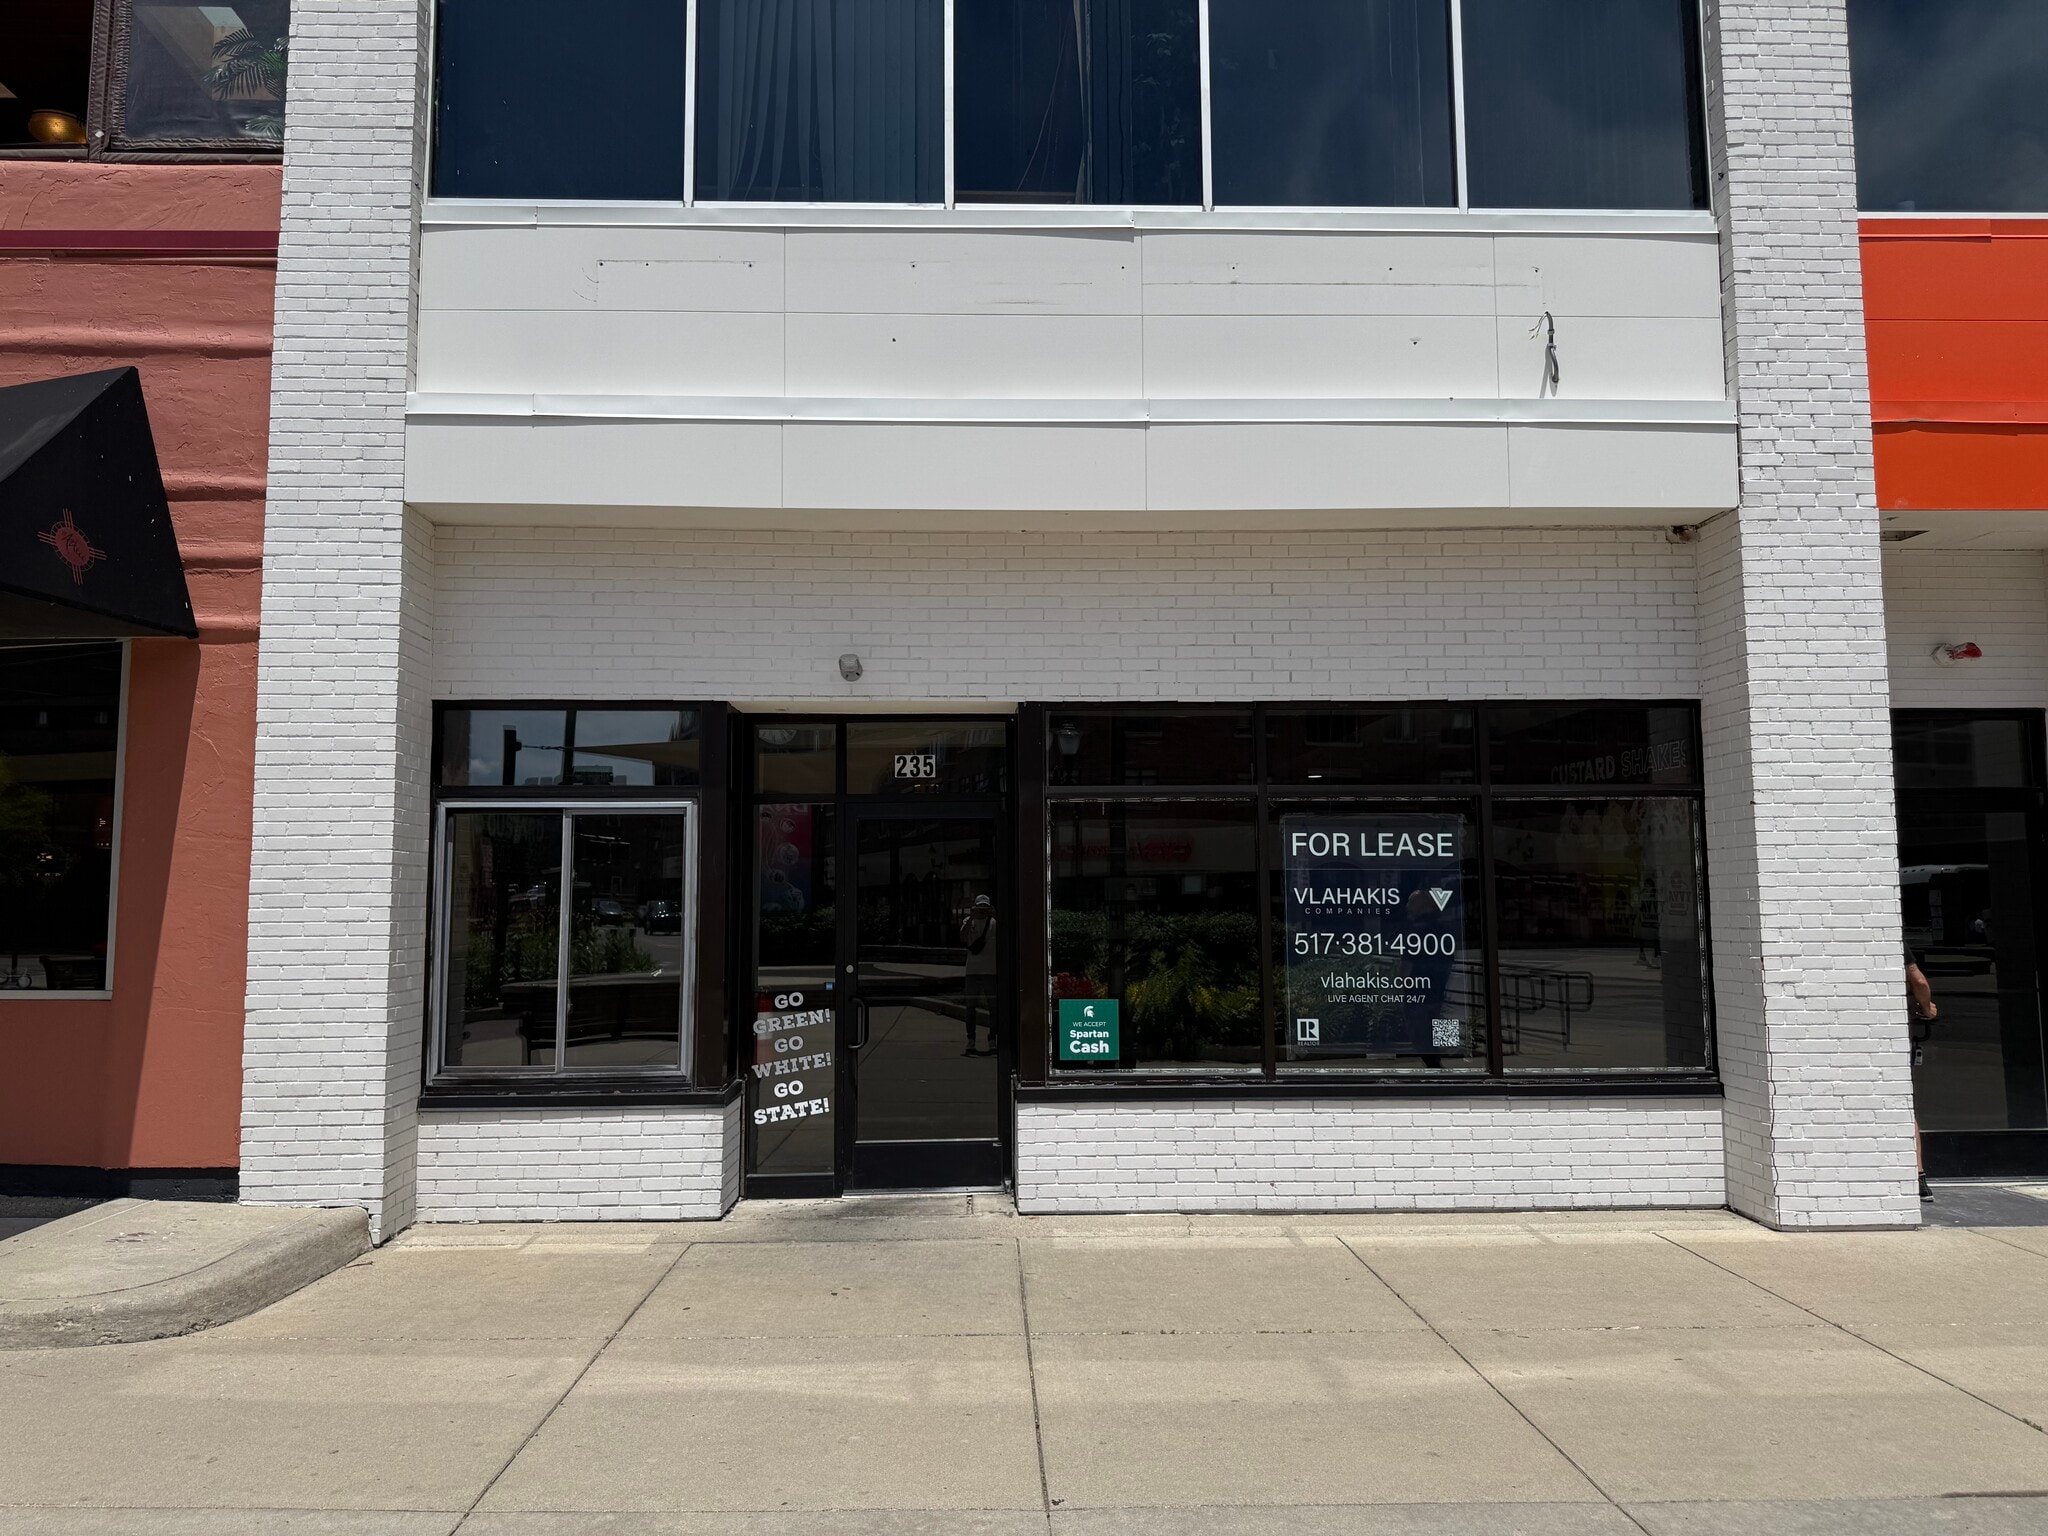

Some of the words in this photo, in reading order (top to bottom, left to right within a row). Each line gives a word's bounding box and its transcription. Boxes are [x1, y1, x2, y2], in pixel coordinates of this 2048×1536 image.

[896, 756, 933, 776] 235
[1552, 755, 1615, 784] CUSTARD
[1292, 833, 1350, 857] FOR
[1361, 833, 1454, 856] LEASE
[1294, 888, 1400, 905] VLAHAKIS
[1321, 972, 1431, 989] vlahakis.com
[774, 992, 804, 1009] GO
[1328, 995, 1346, 1003] LIVE
[1349, 995, 1379, 1003] AGENT
[1381, 995, 1404, 1003] CHAT
[1406, 995, 1426, 1003] 24/7
[753, 1009, 831, 1034] GREEN!
[1070, 1030, 1109, 1039] Spartan
[774, 1036, 804, 1053] GO
[1070, 1040, 1109, 1053] Cash
[752, 1052, 832, 1079] WHITE!
[774, 1080, 804, 1098] GO
[754, 1098, 830, 1125] STATE!
